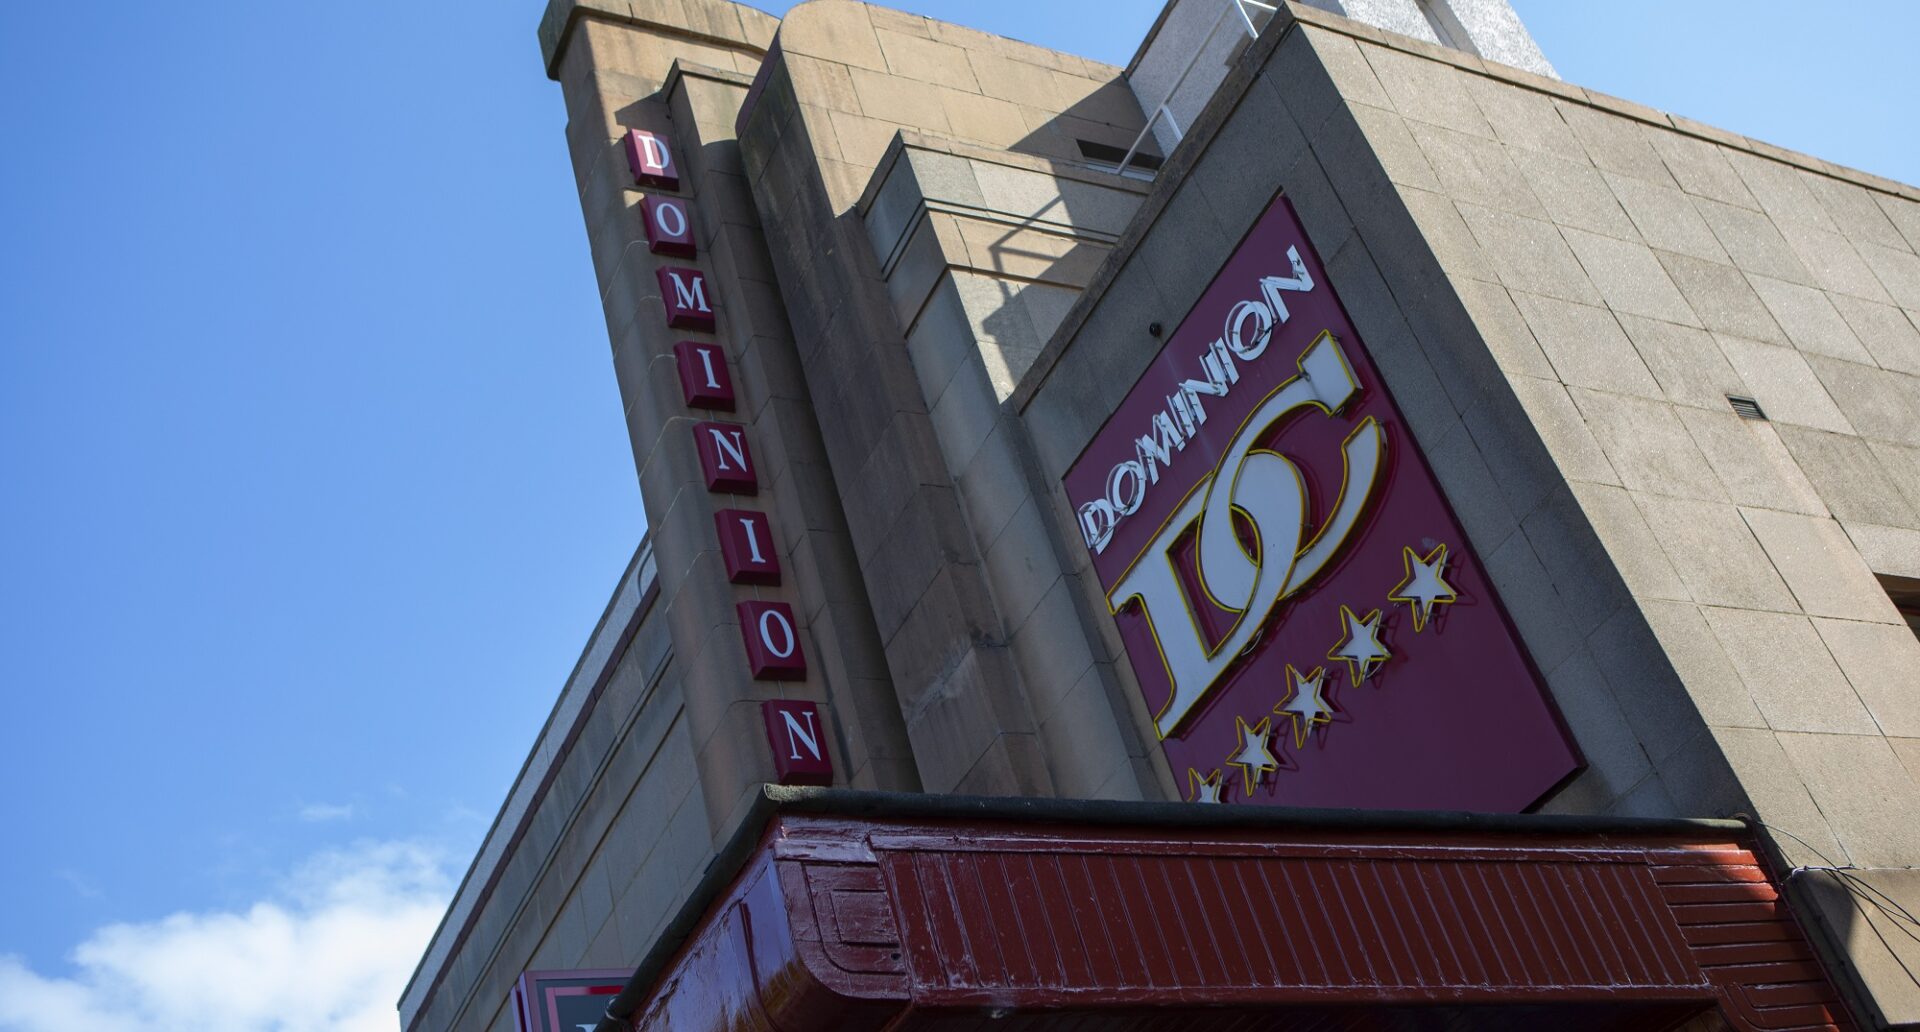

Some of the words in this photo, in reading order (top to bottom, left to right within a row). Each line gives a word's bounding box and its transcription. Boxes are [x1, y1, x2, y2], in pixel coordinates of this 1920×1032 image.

[637, 134, 821, 761] DOMINION
[1077, 244, 1315, 555] DOMINION
[1106, 329, 1387, 741] DC
